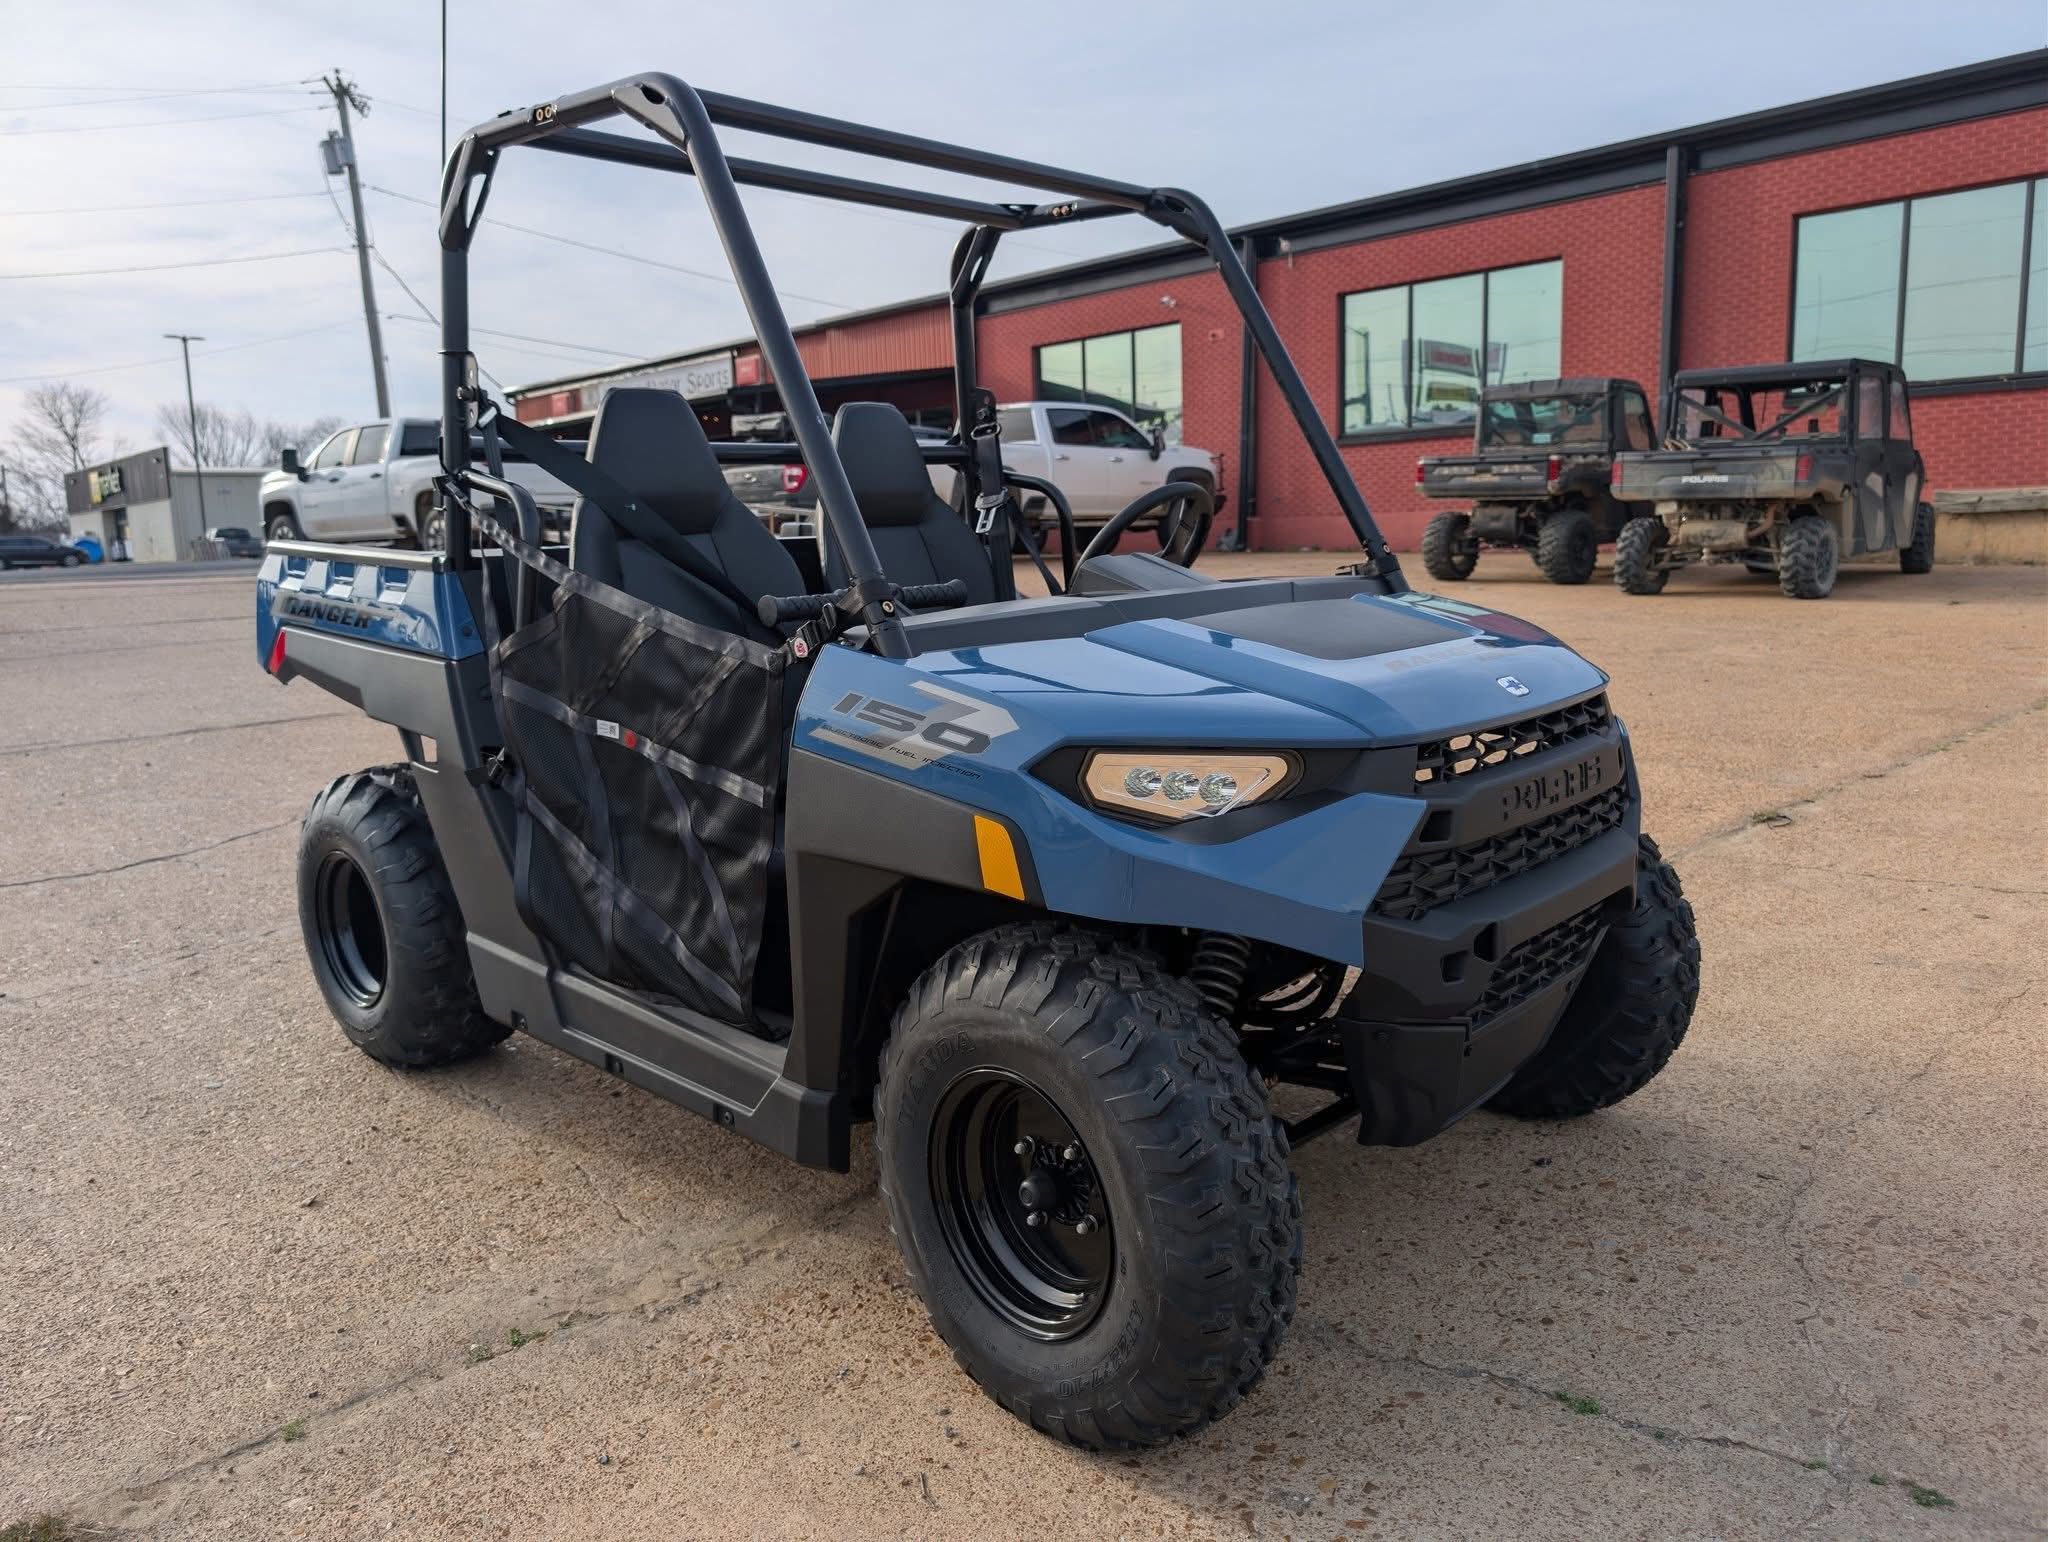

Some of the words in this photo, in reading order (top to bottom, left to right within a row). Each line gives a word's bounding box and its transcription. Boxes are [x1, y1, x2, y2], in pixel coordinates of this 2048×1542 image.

[285, 596, 370, 629] RANGER
[822, 724, 884, 749] ELECTRONIC
[889, 746, 917, 759] FUEL
[922, 757, 985, 780] INJECTION
[832, 691, 991, 754] 150
[1501, 755, 1601, 823] POLARIS
